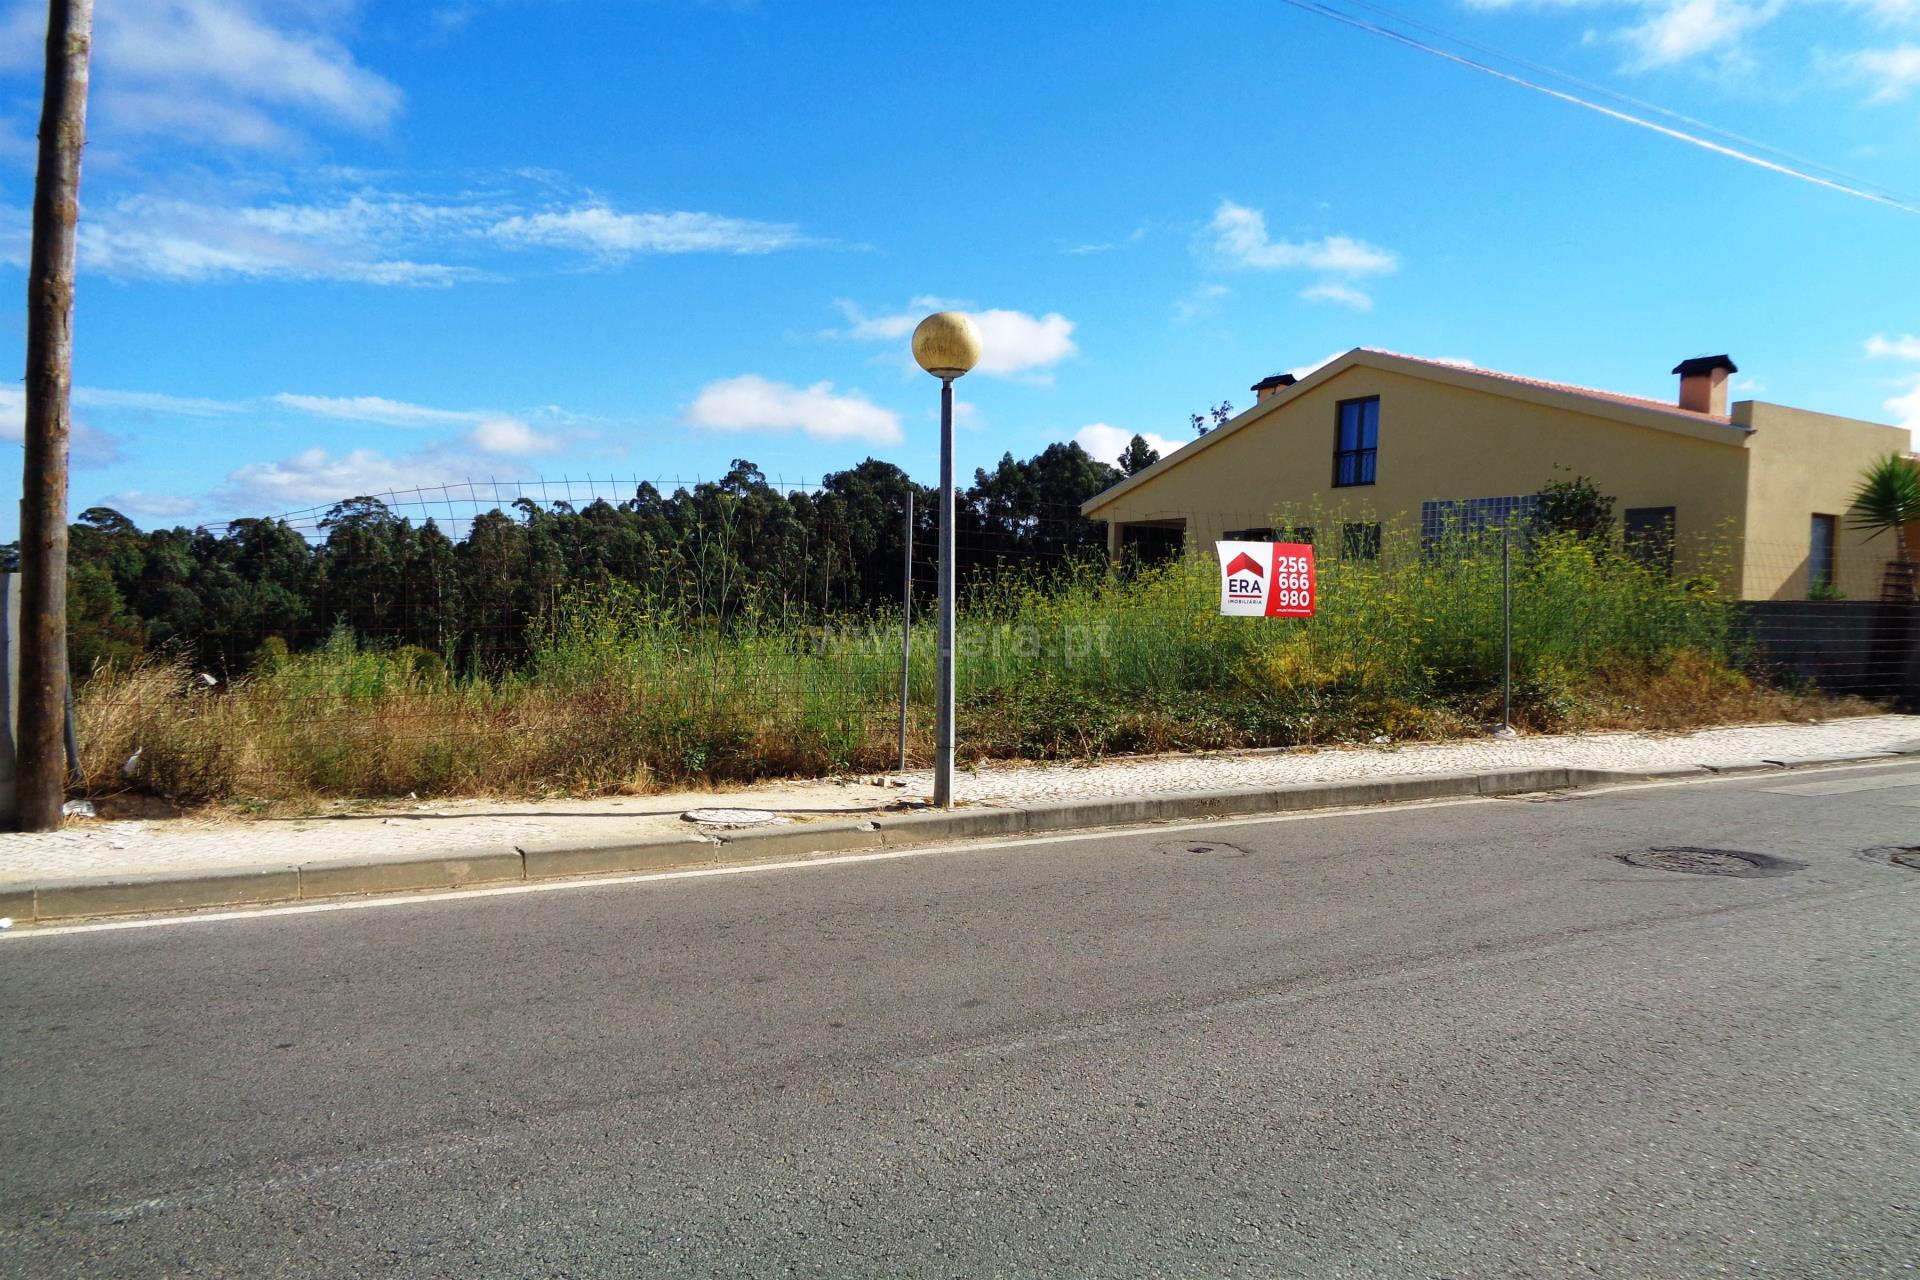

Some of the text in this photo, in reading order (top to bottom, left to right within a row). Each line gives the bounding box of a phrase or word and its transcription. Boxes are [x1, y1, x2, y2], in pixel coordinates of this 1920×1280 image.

[1278, 556, 1308, 573] 256
[1229, 579, 1262, 593] ERA
[1278, 573, 1310, 589] 666
[1279, 590, 1310, 607] 980
